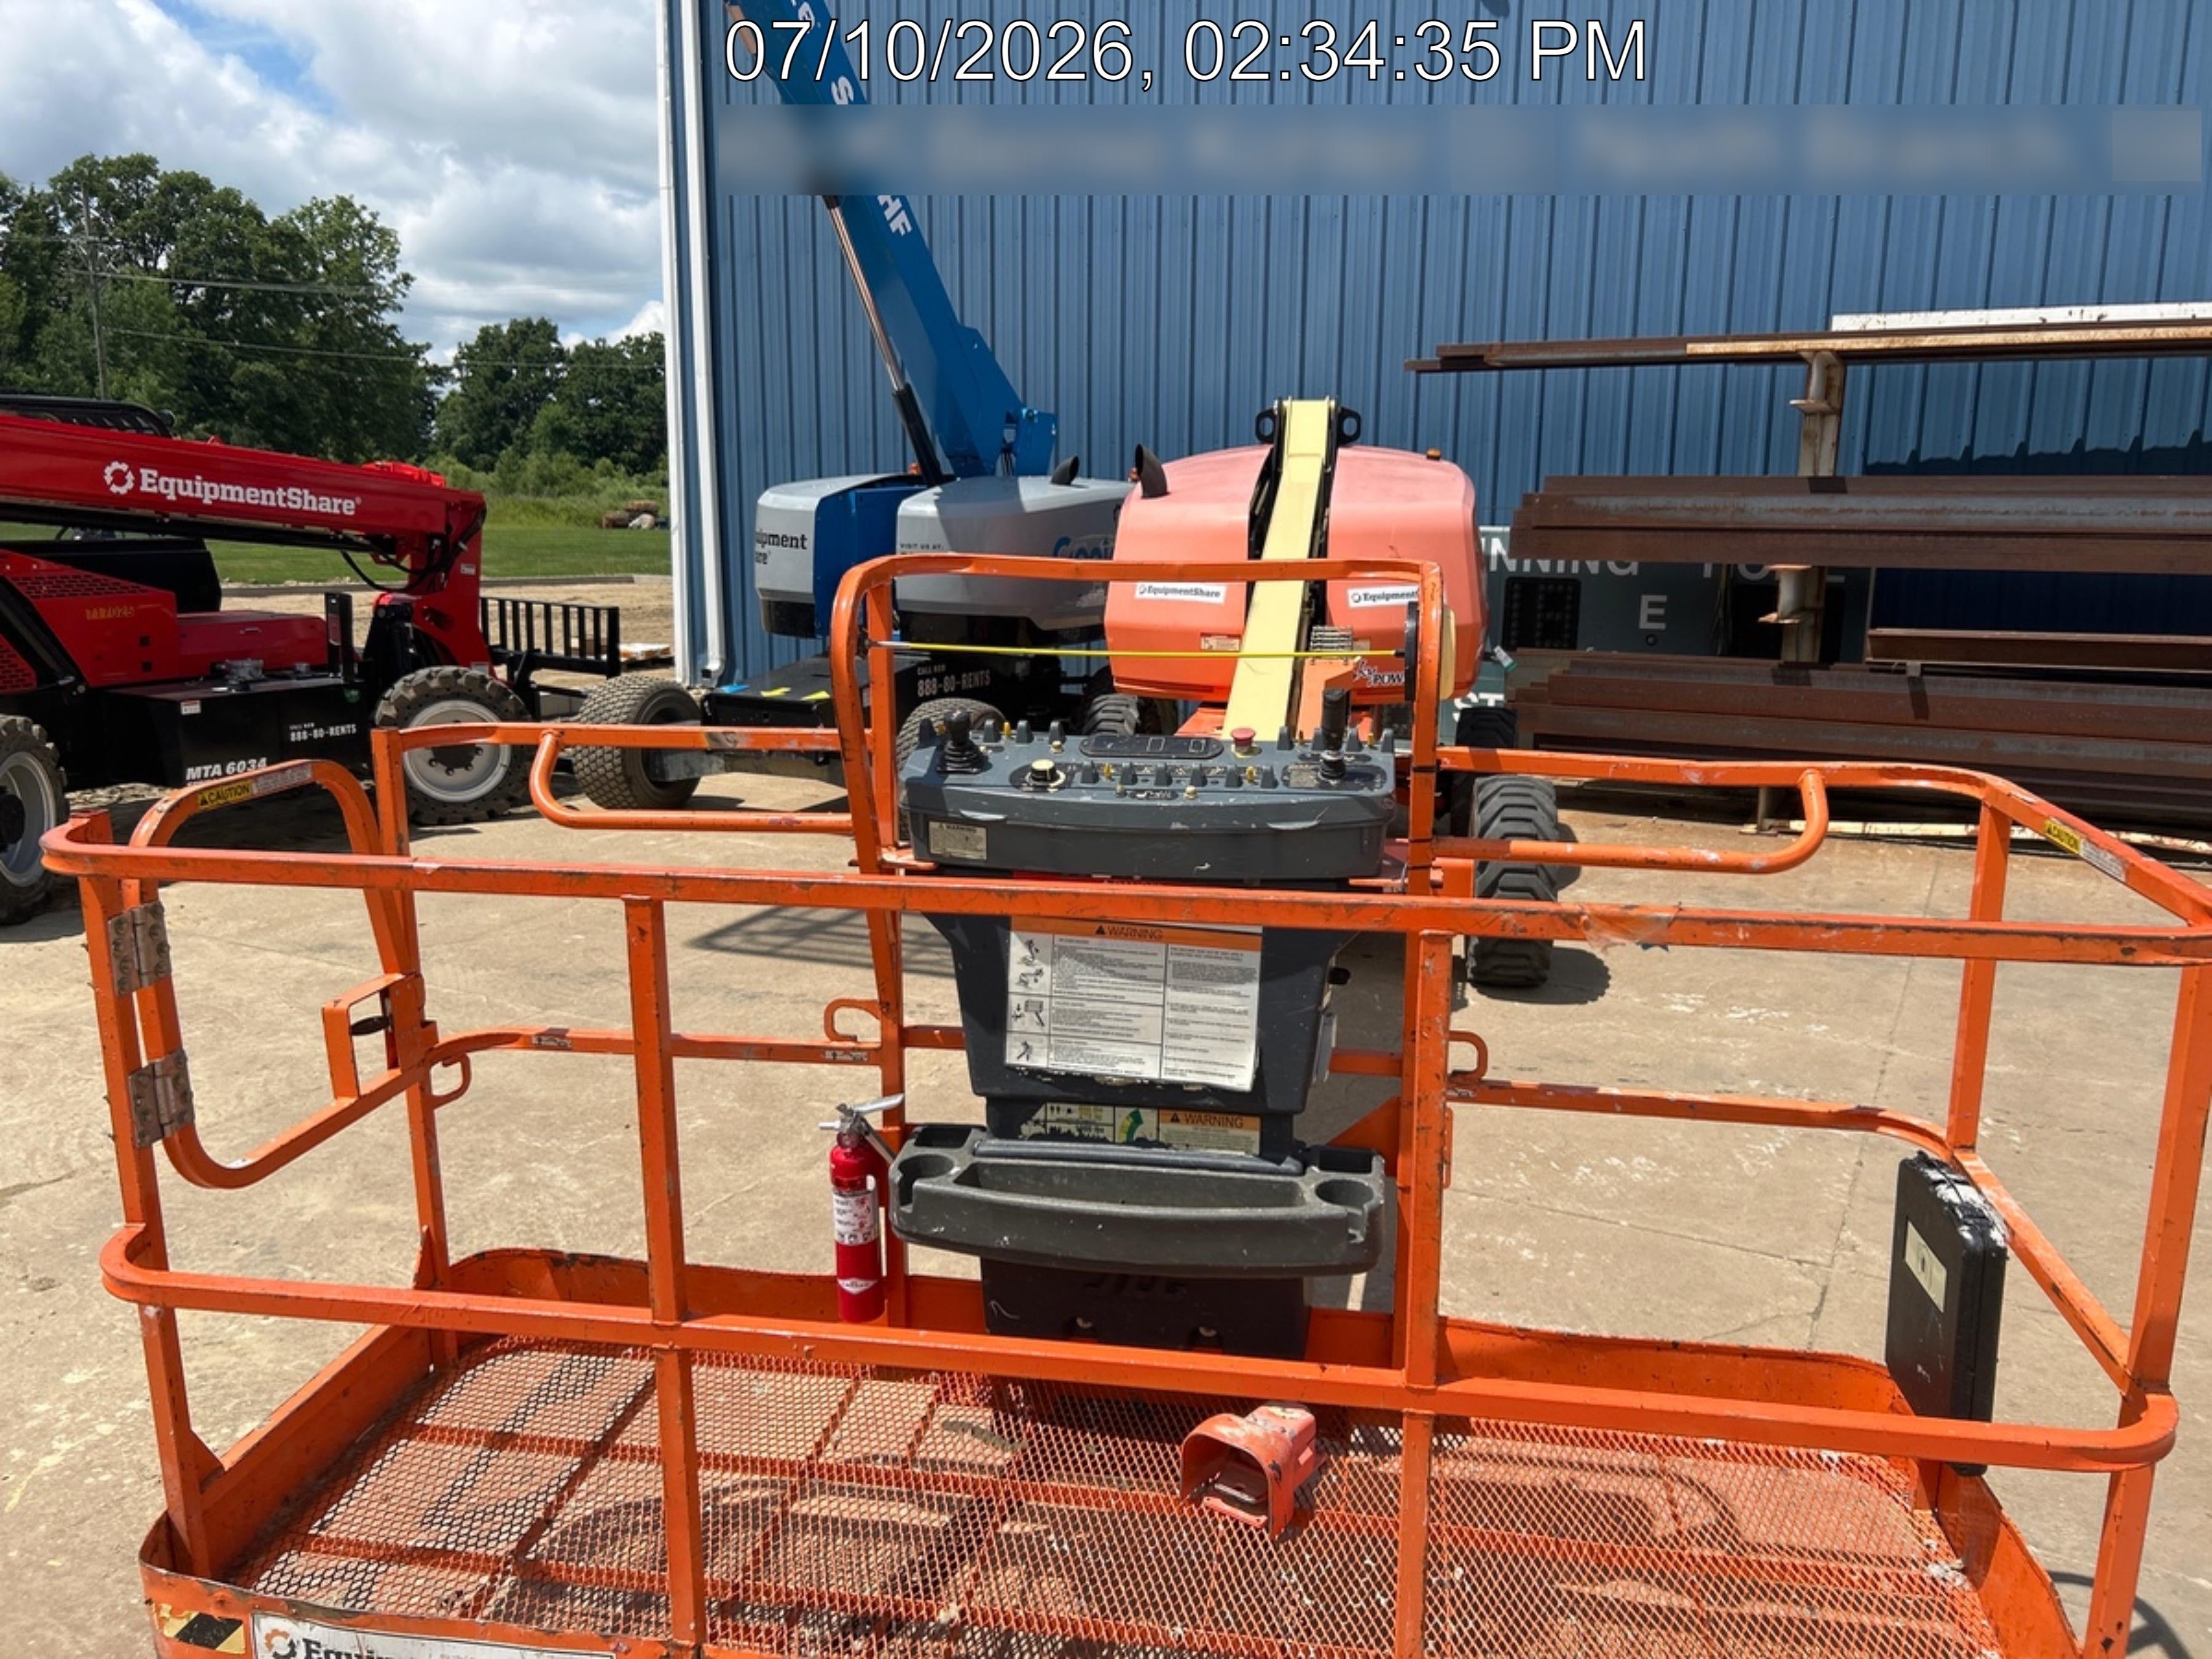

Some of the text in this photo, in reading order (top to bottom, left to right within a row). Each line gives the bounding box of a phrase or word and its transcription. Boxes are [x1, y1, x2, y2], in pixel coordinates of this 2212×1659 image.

[139, 467, 356, 516] EquipmentShare
[1147, 585, 1221, 598] EquipmentShare
[1363, 589, 1419, 602] Equipment
[1639, 595, 1667, 629] E
[917, 669, 990, 697] 888-80-RENTS
[290, 723, 356, 742] 888-80-RENTS
[186, 756, 267, 780] MTA 6034
[208, 782, 251, 805] CAUTION
[1107, 924, 1164, 941] WARNING
[1185, 1112, 1244, 1129] WARNING
